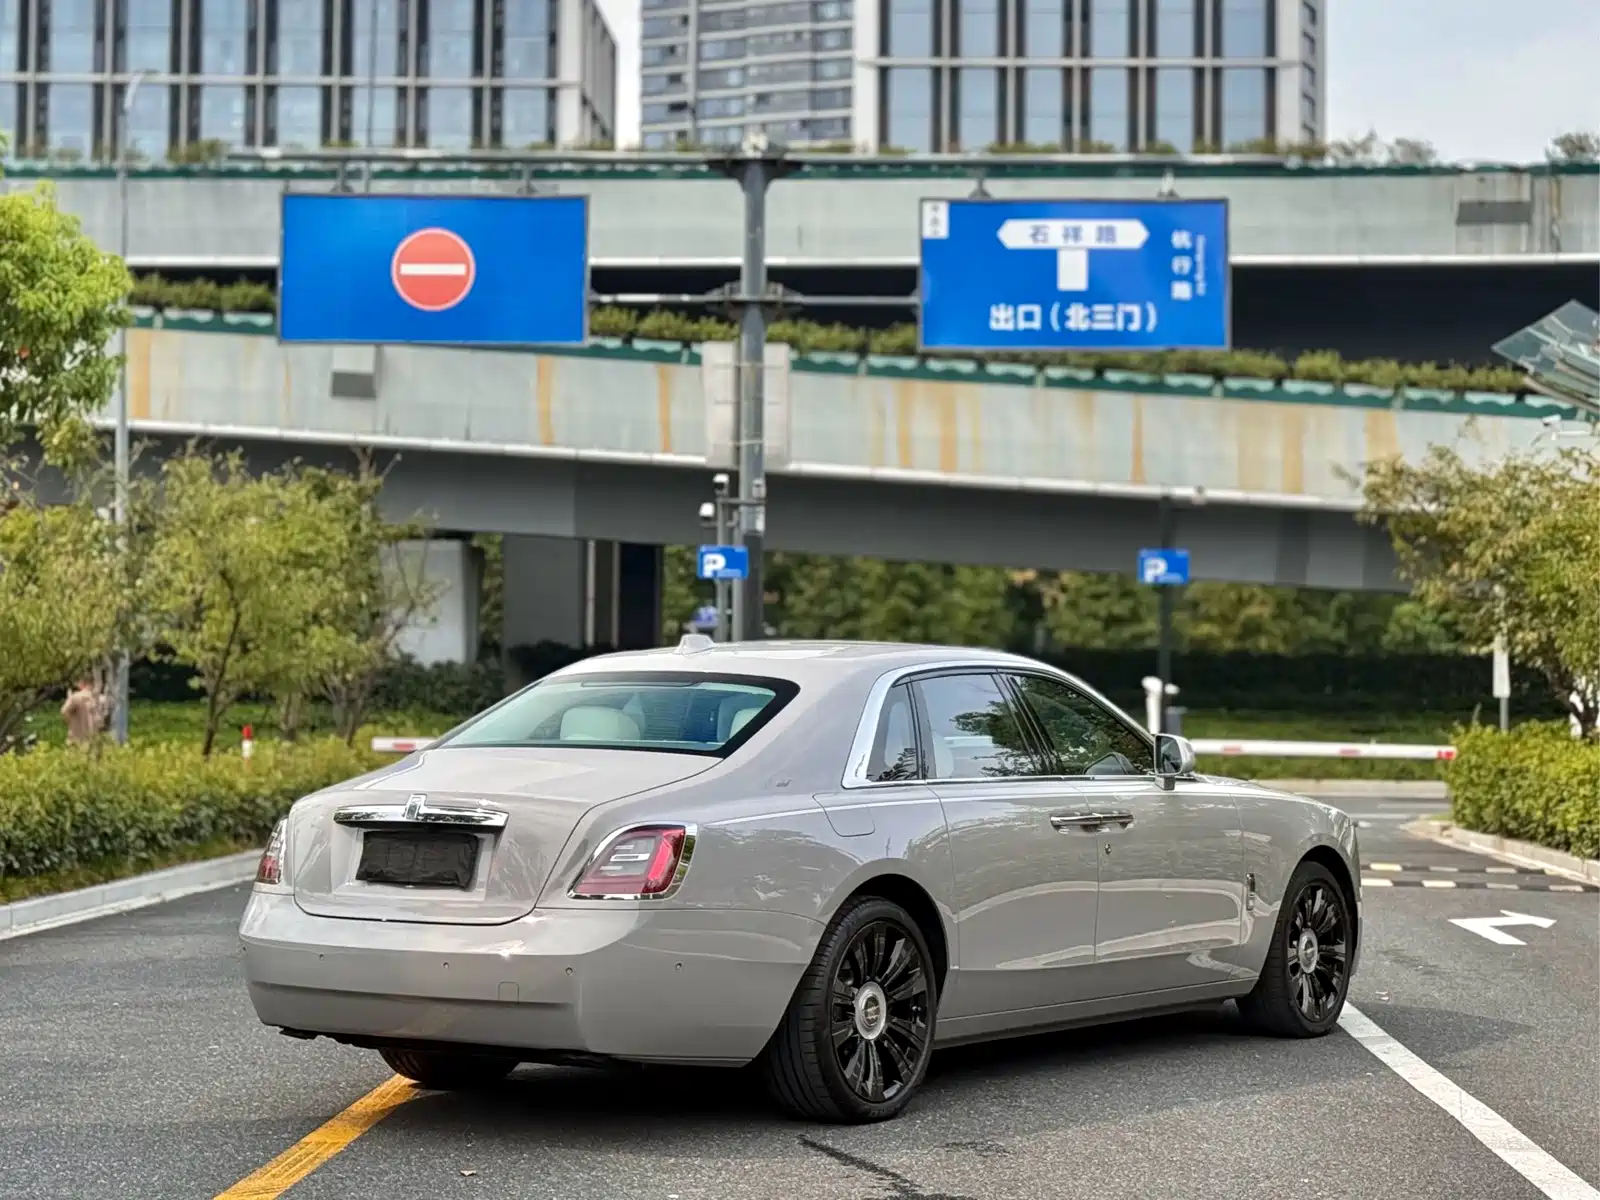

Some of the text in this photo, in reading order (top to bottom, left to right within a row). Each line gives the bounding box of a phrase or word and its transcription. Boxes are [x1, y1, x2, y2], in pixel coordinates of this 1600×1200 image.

[1028, 224, 1118, 245] 石祥路
[702, 553, 727, 578] P
[1143, 557, 1168, 584] P
